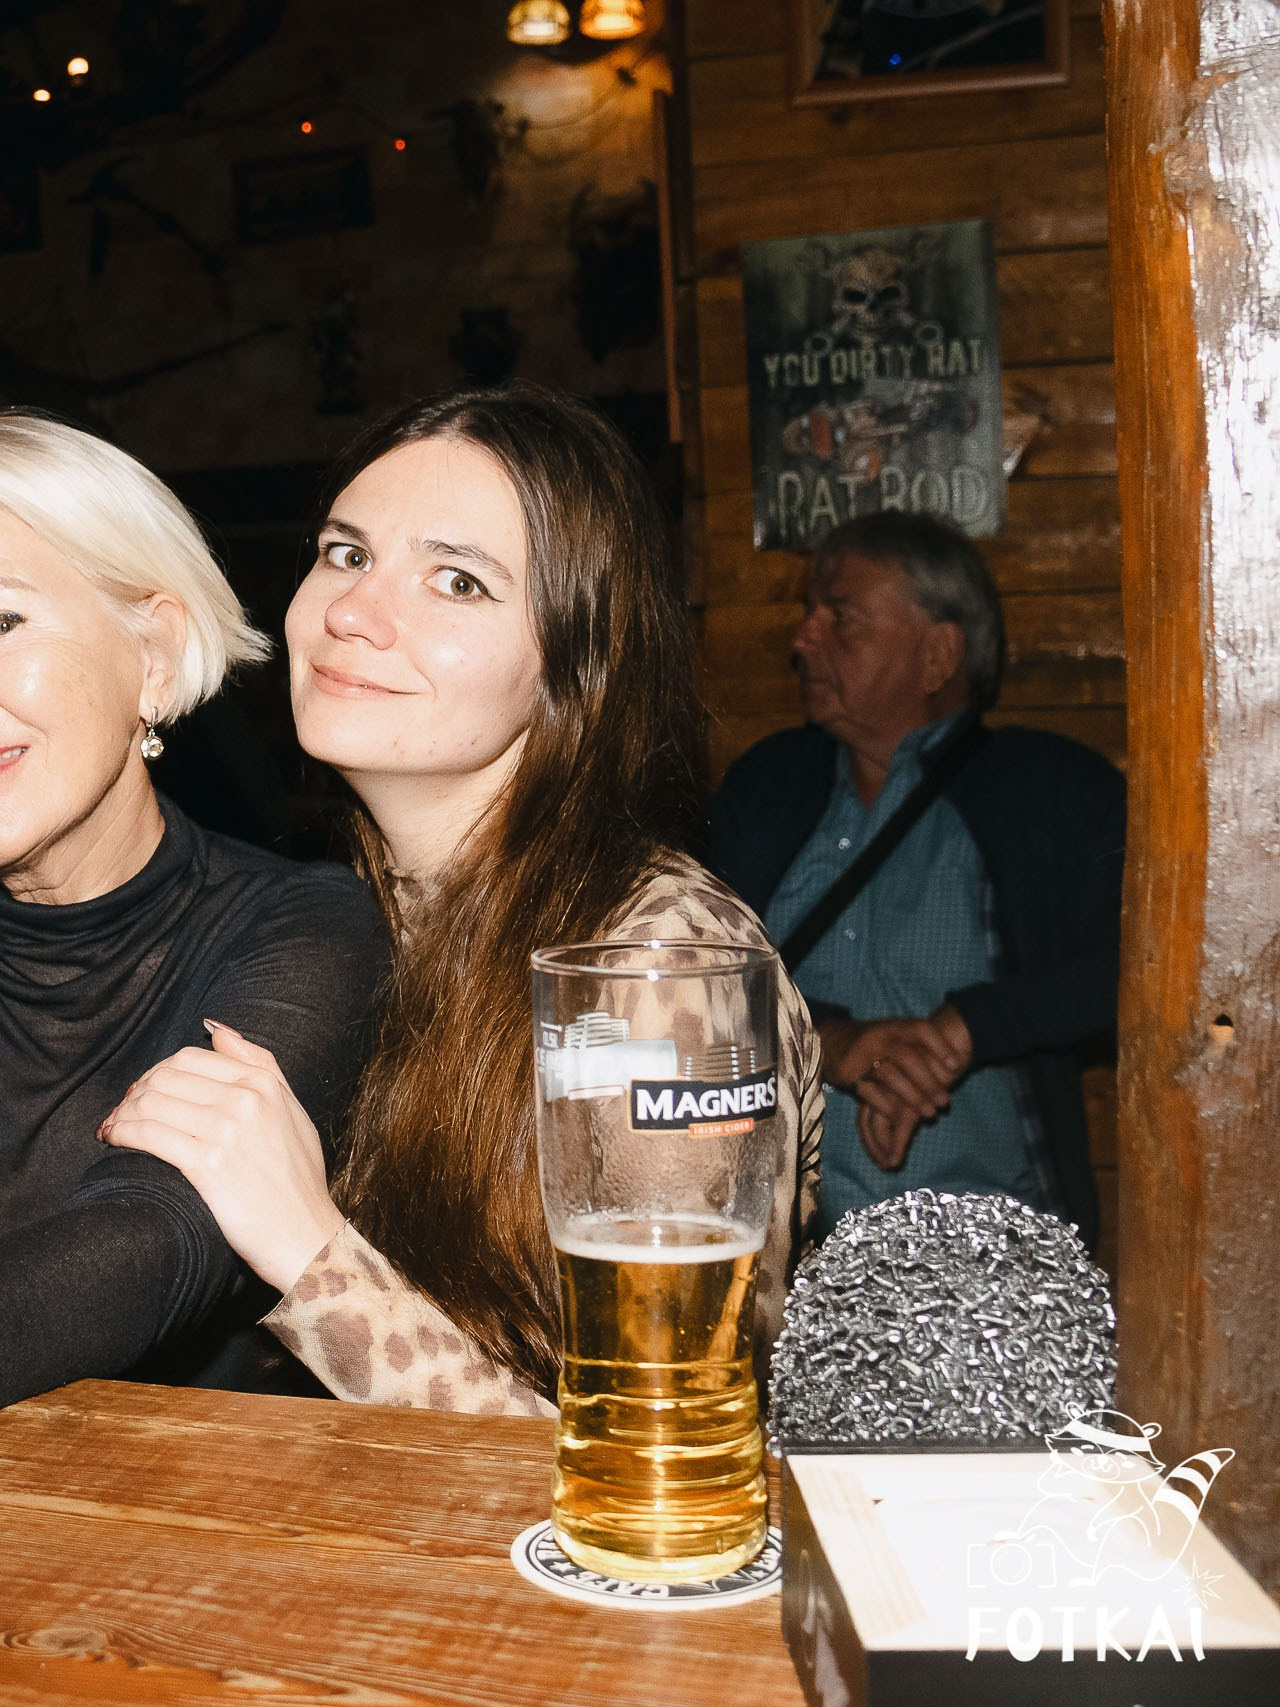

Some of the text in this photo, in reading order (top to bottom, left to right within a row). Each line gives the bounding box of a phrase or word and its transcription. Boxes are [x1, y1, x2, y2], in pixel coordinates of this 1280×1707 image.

[763, 337, 981, 389] YOU DIRTY RAT
[777, 465, 988, 543] RAT ROD
[636, 1077, 777, 1122] MAGNERS
[693, 1121, 750, 1135] IRISH CIDER
